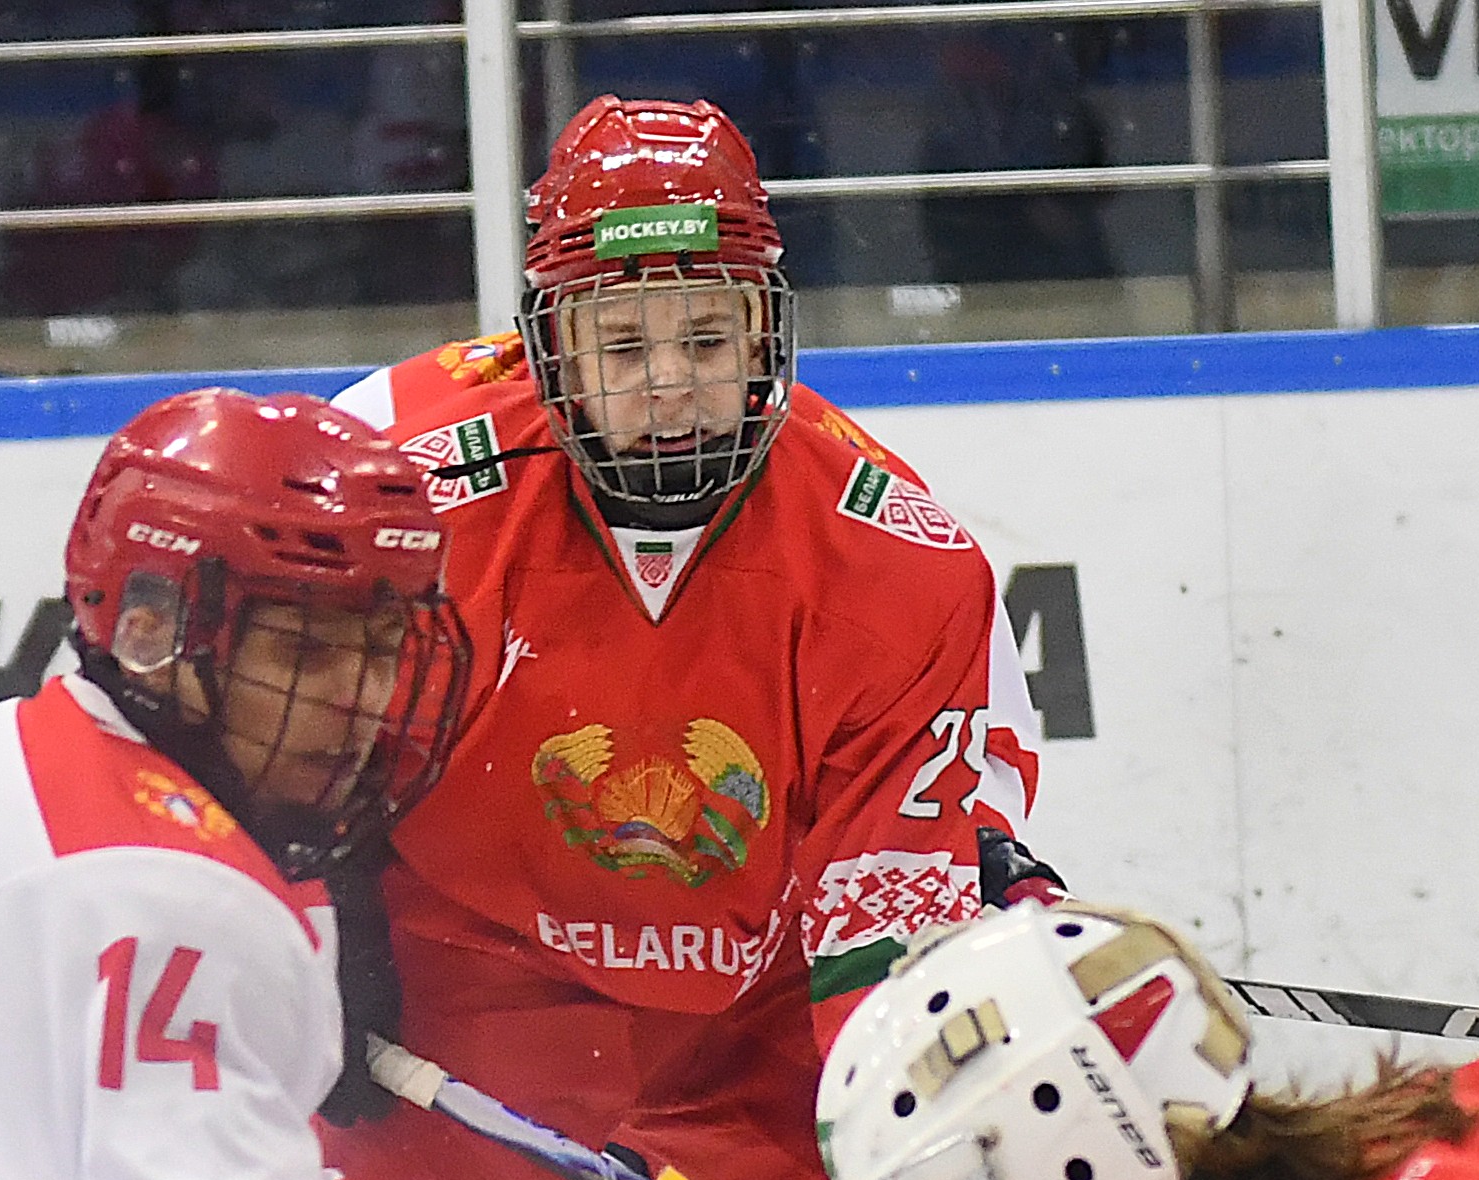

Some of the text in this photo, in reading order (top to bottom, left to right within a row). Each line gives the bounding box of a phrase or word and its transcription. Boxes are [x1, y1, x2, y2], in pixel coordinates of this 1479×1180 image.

[601, 219, 708, 242] HOCKEY.BY
[126, 521, 203, 556] CCM
[97, 936, 220, 1091] 14
